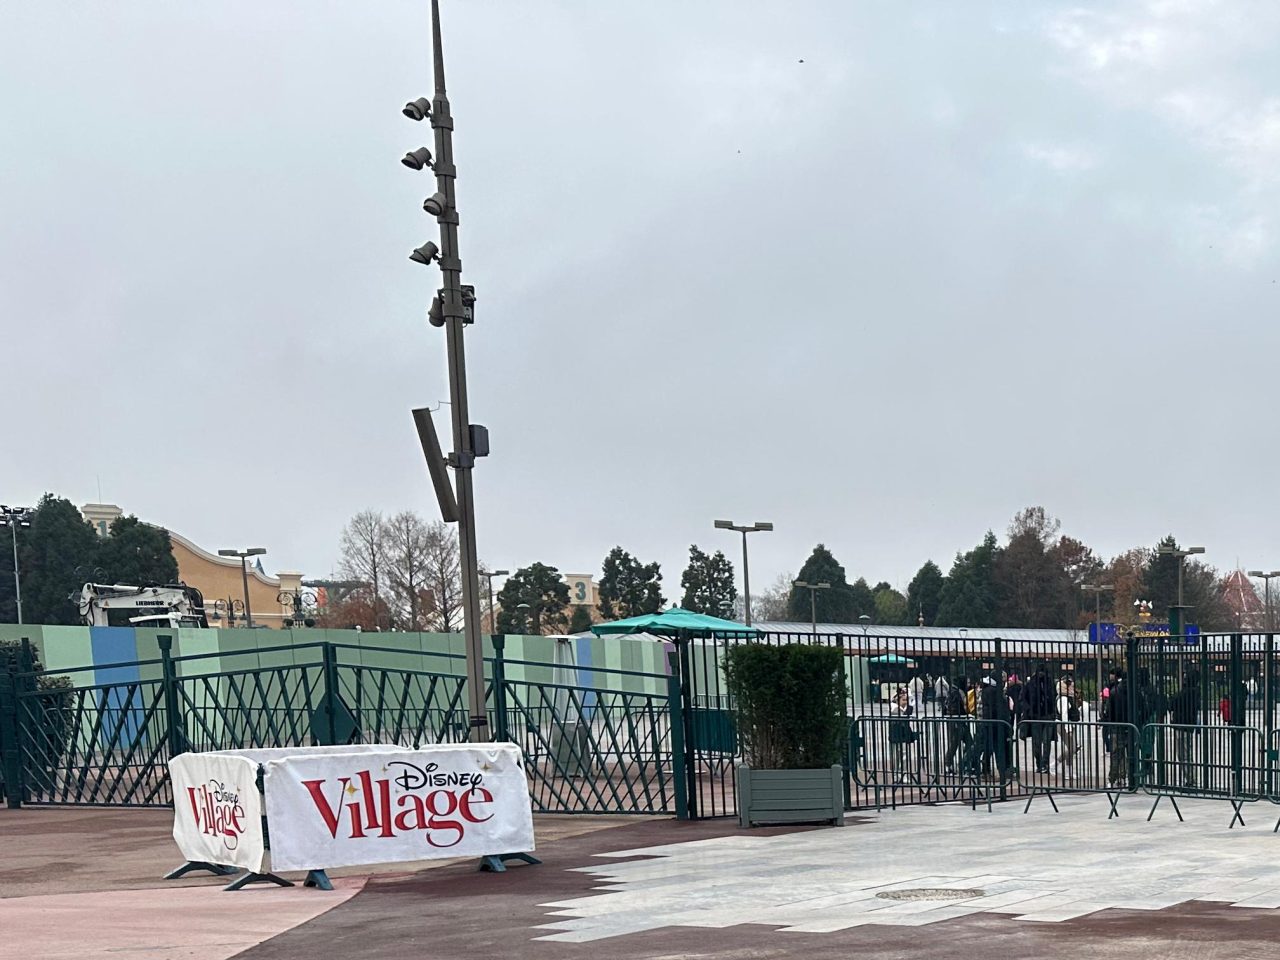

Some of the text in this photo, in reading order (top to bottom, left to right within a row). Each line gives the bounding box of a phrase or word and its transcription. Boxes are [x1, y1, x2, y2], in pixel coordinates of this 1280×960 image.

[575, 581, 587, 600] 3
[187, 784, 246, 850] Village
[301, 770, 495, 848] Village
